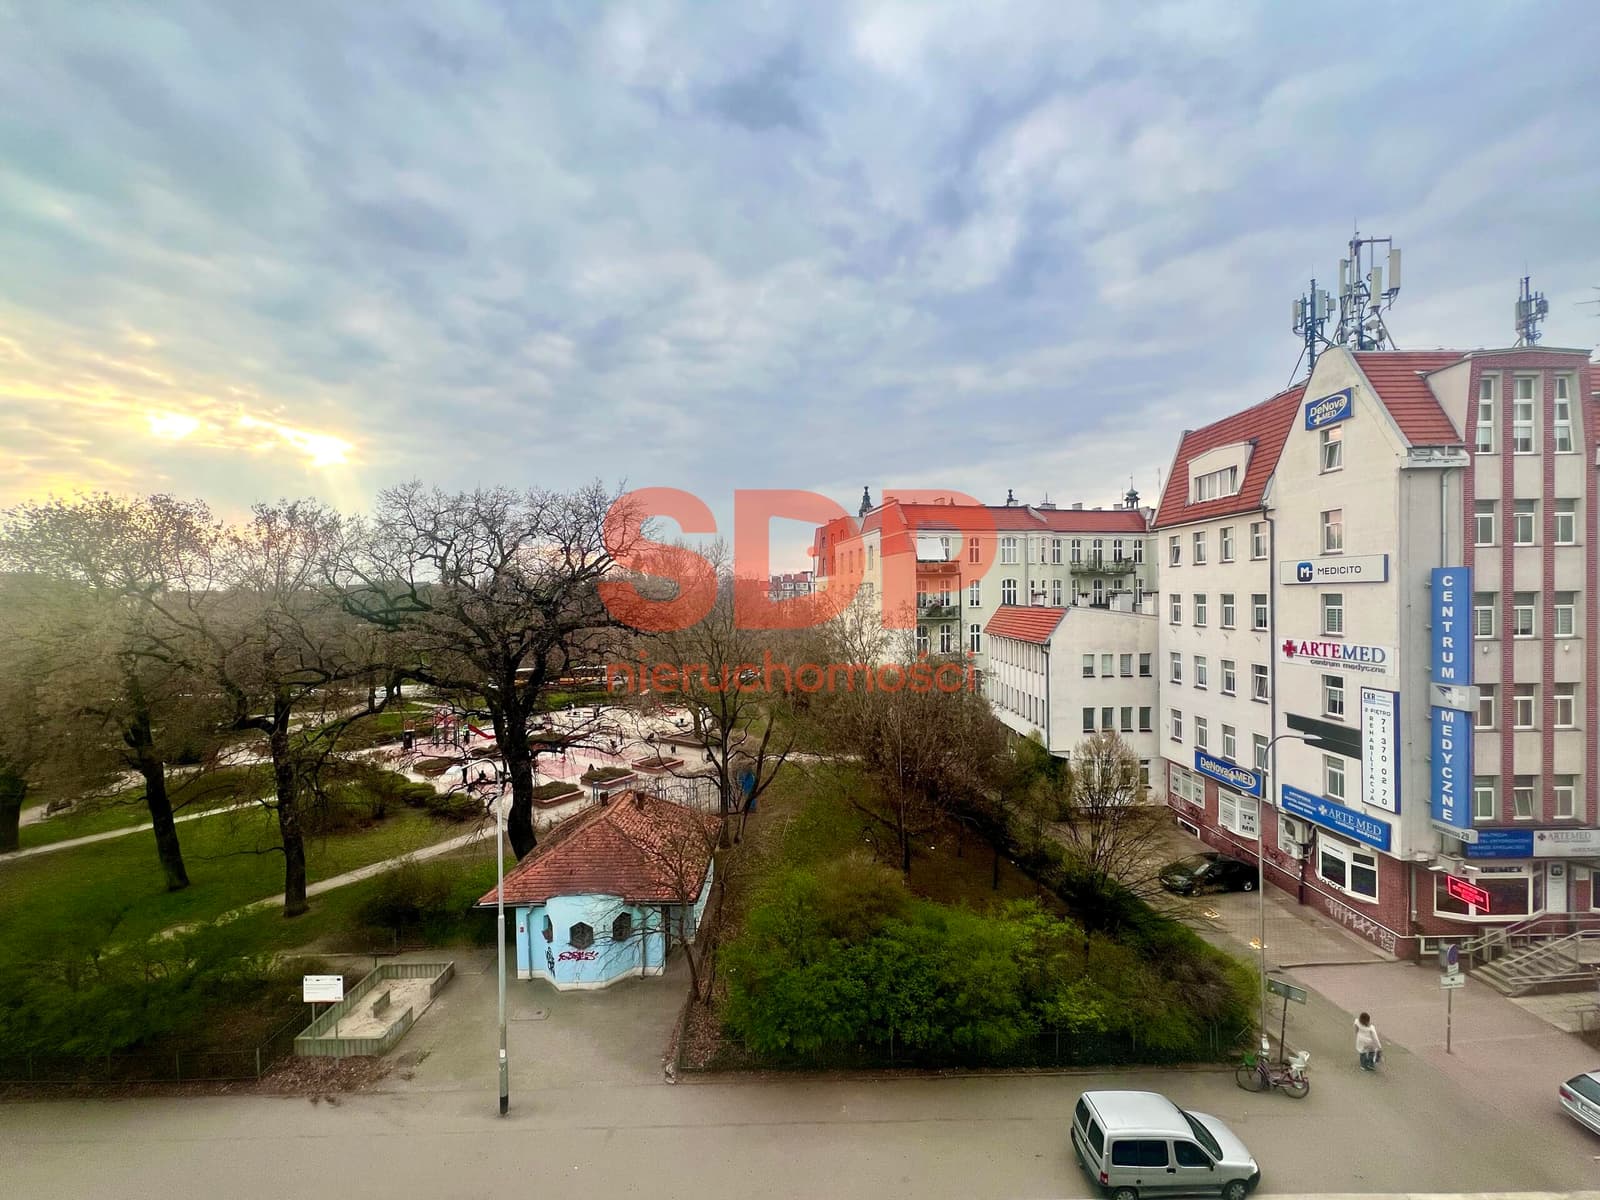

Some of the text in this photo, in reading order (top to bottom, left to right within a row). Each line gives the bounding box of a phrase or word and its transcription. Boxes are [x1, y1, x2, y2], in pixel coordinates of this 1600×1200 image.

[1310, 398, 1345, 417] DeNova
[1317, 565, 1362, 575] MEDICITO
[1441, 575, 1455, 679] CENTRUM
[1299, 641, 1386, 663] ARTEMED
[1310, 659, 1386, 674] centrum medyczne
[1200, 757, 1229, 777] DeNova
[1441, 710, 1454, 822] MEDYCZNE
[1241, 824, 1255, 832] MR
